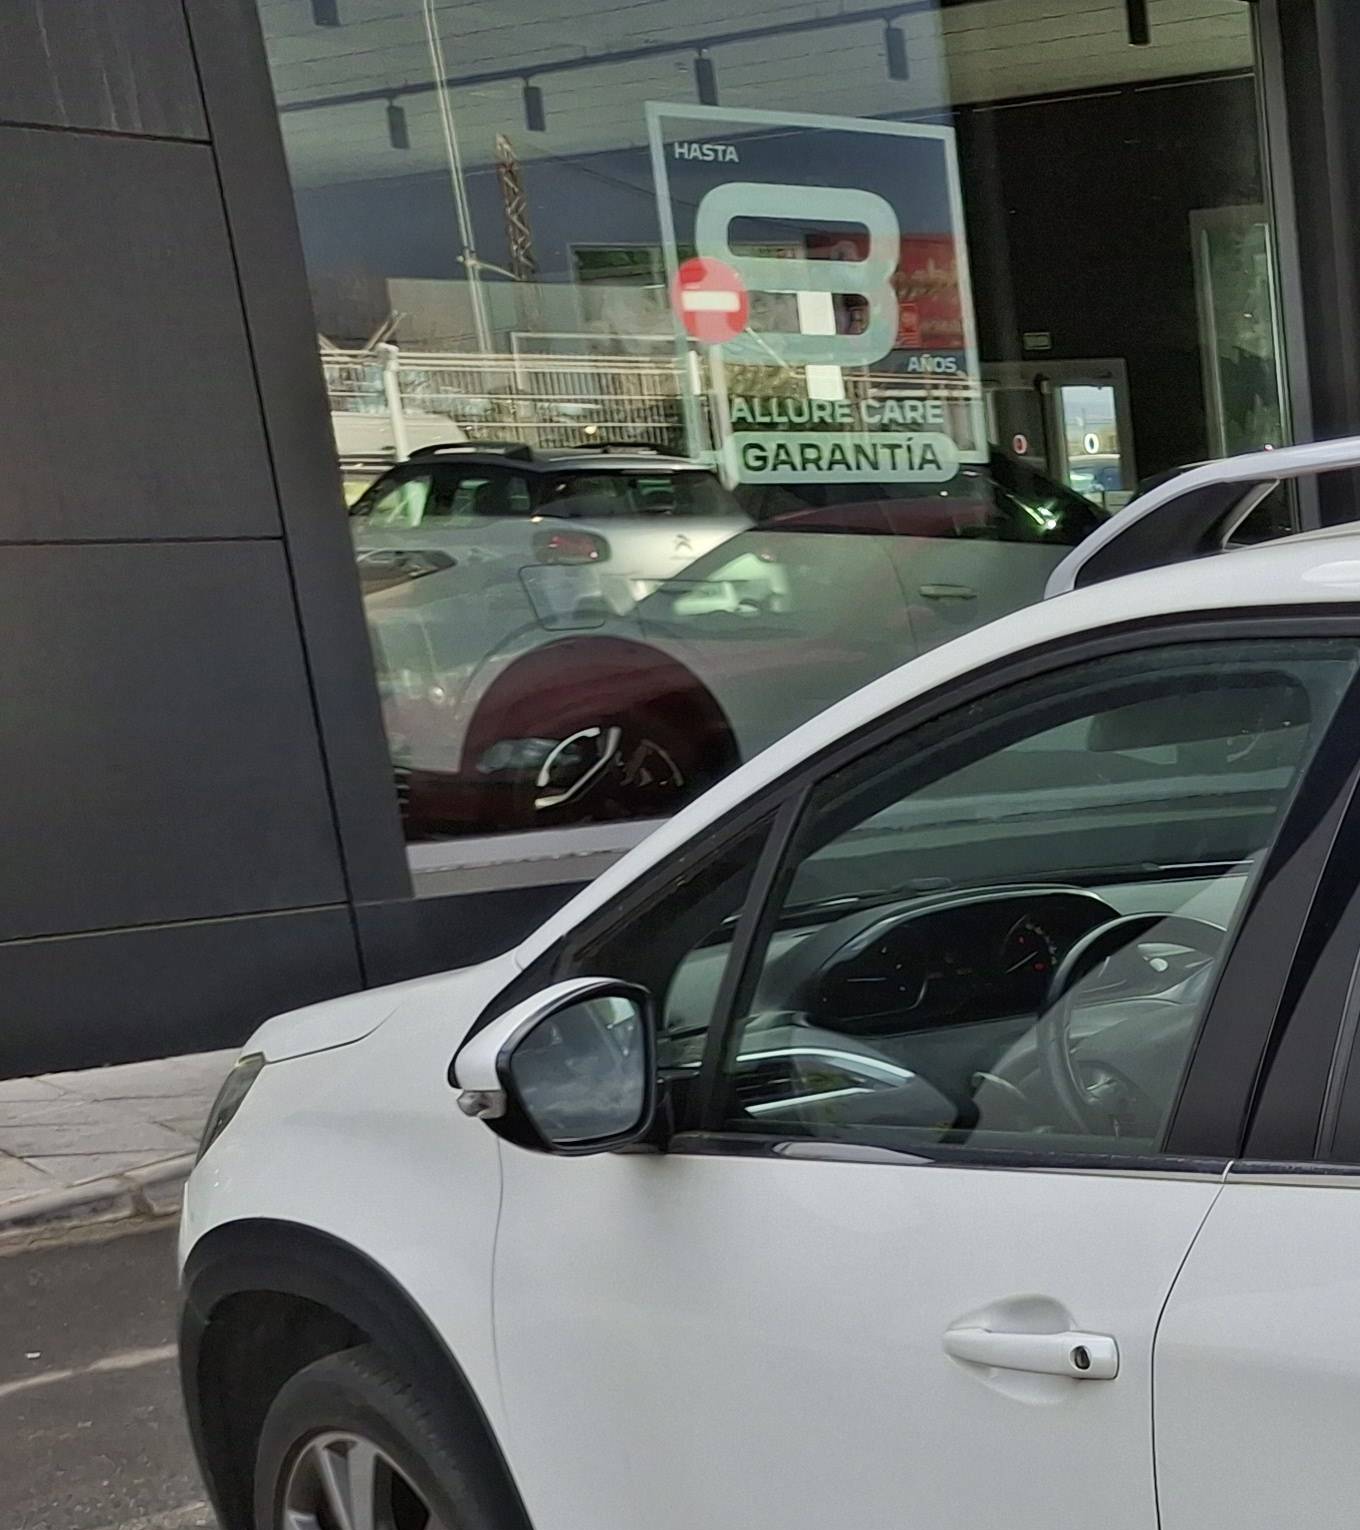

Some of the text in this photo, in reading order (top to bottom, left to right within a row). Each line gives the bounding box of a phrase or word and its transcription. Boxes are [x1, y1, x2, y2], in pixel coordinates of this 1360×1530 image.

[674, 142, 739, 163] HASTA
[695, 182, 899, 367] 8
[907, 356, 957, 373] AÑOS
[731, 398, 944, 424] ALLURE CARE
[743, 437, 943, 473] GARANTÍA
